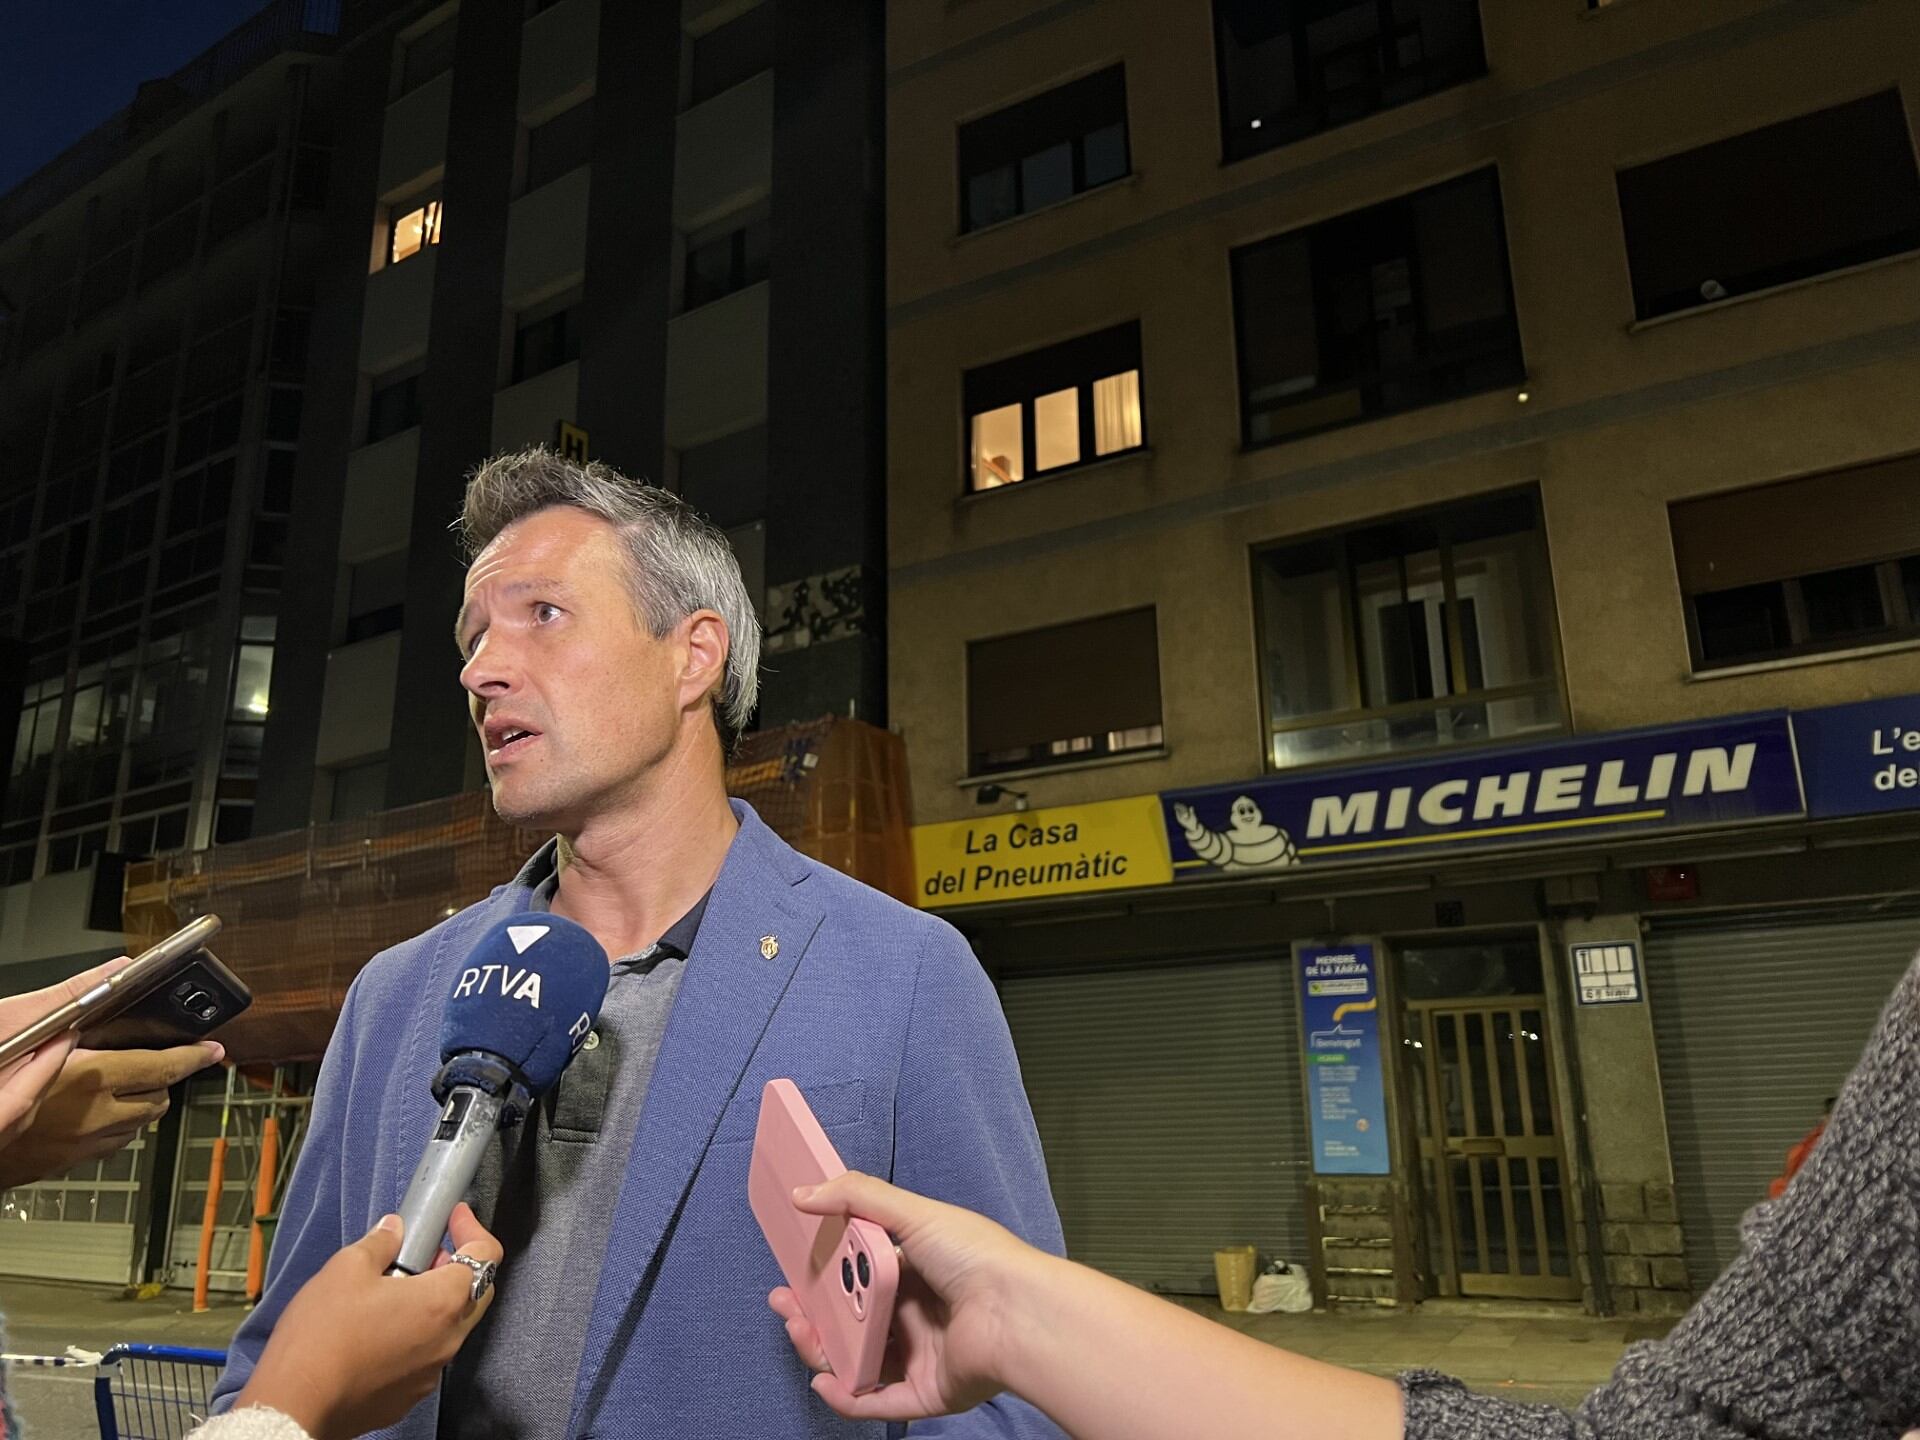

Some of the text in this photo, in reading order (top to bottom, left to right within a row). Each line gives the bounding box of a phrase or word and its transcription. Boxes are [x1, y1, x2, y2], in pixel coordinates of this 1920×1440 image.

[1305, 742, 1758, 840] MICHELIN
[1875, 763, 1920, 791] de
[965, 823, 1078, 854] La Casa
[924, 851, 1129, 896] del Pneumàtic
[453, 964, 542, 1009] RTVA
